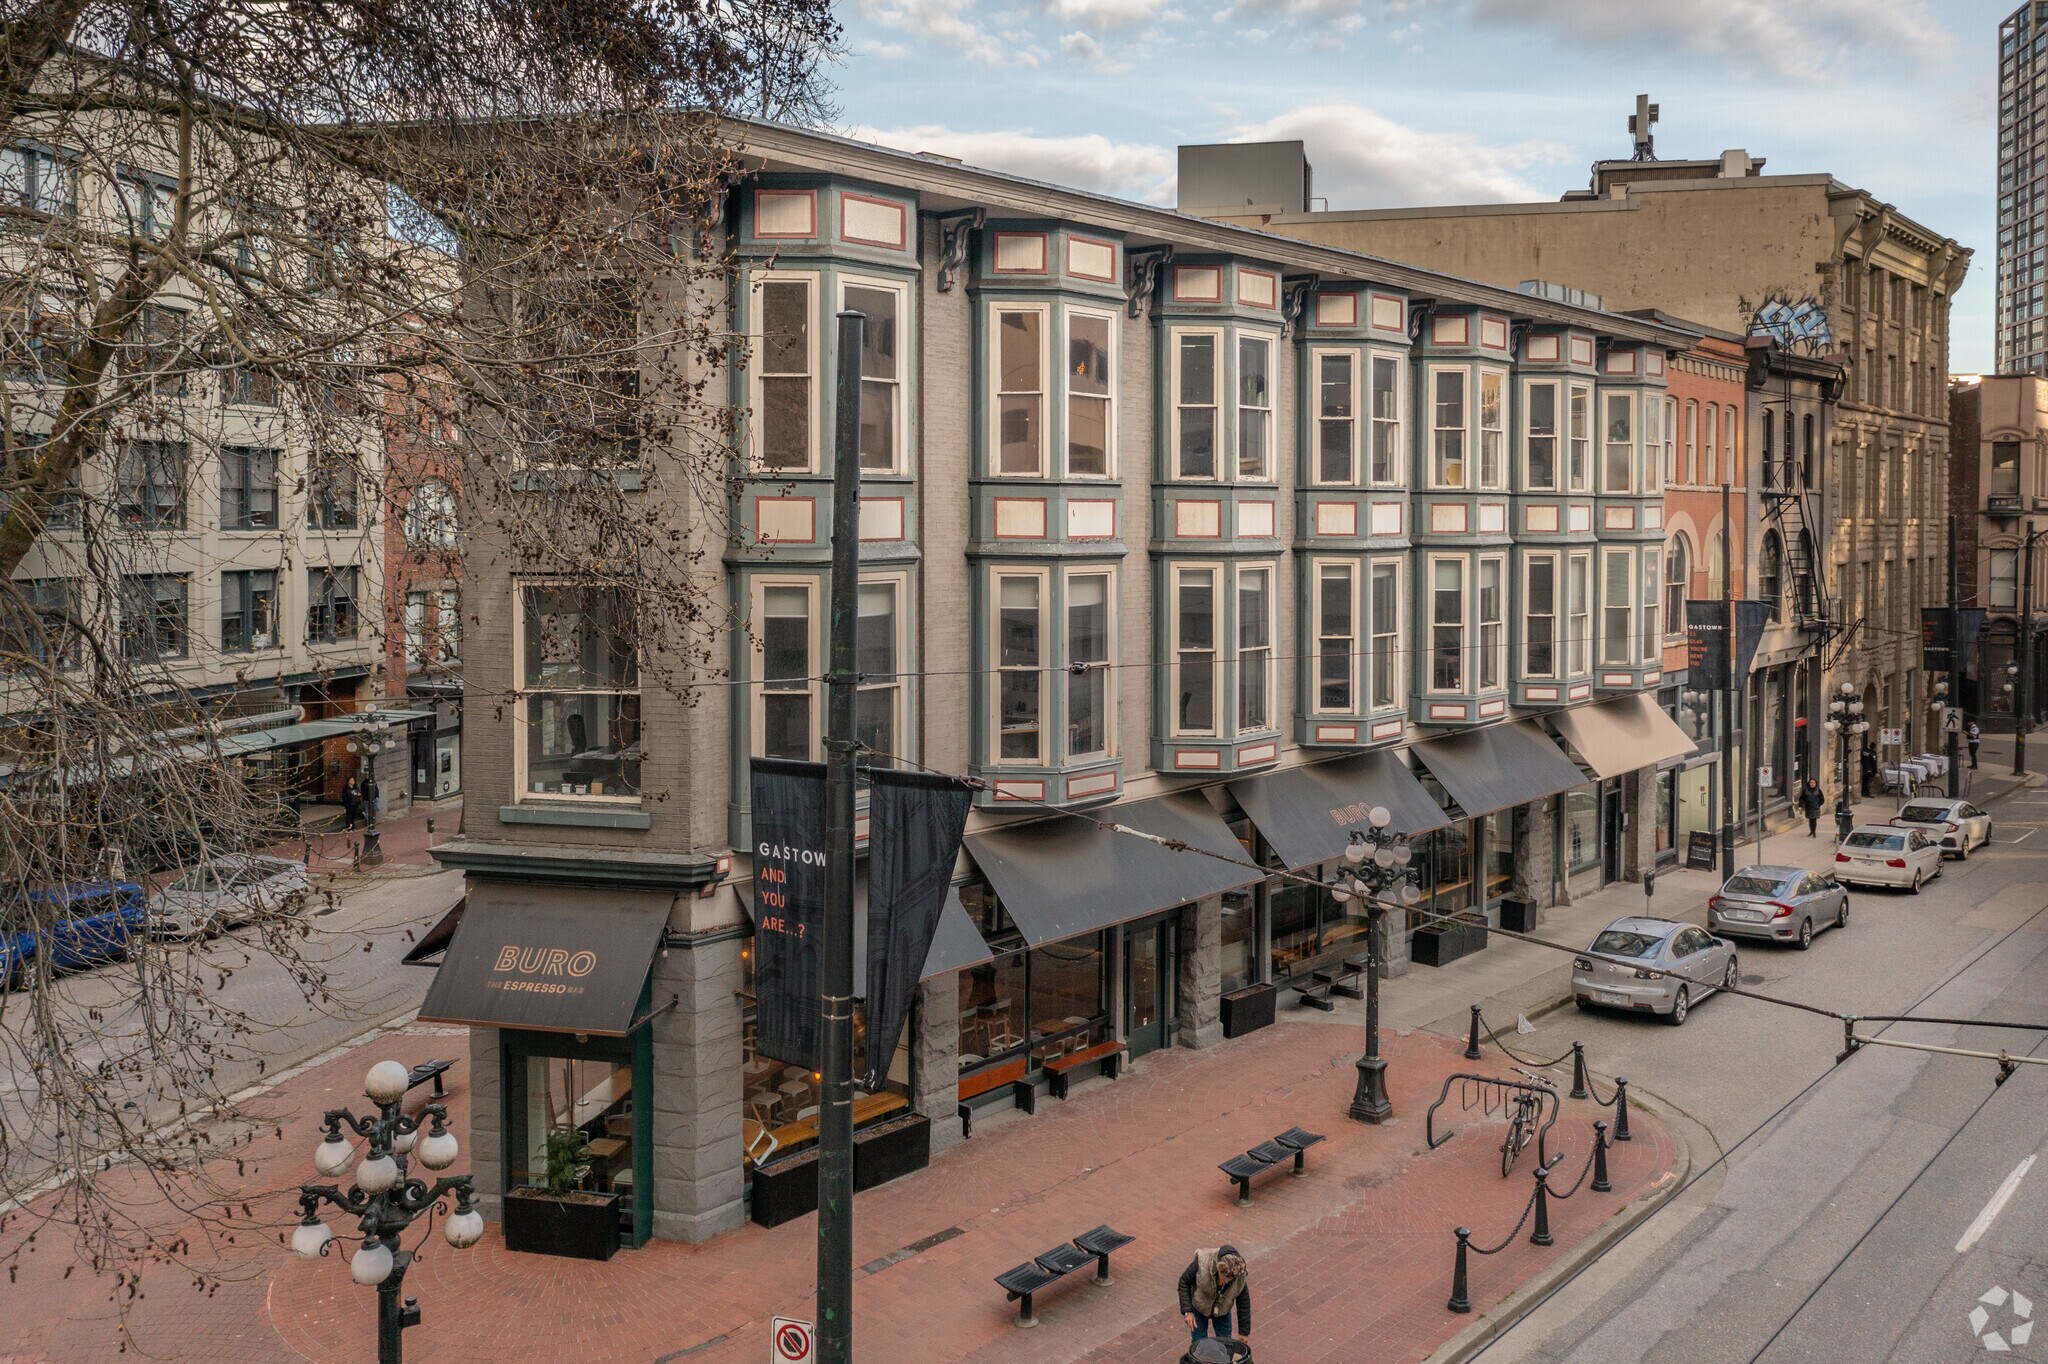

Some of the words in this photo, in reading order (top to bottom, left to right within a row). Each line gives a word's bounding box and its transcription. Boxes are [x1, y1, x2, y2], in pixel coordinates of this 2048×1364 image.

[1329, 801, 1372, 826] BURO
[759, 842, 827, 868] GASTOW
[761, 867, 785, 884] AND
[762, 890, 785, 908] YOU
[762, 916, 806, 939] ARE...?
[493, 945, 597, 977] BURO
[487, 981, 502, 989] THE
[503, 981, 567, 994] ESPRESSO
[567, 986, 585, 995] BAR
